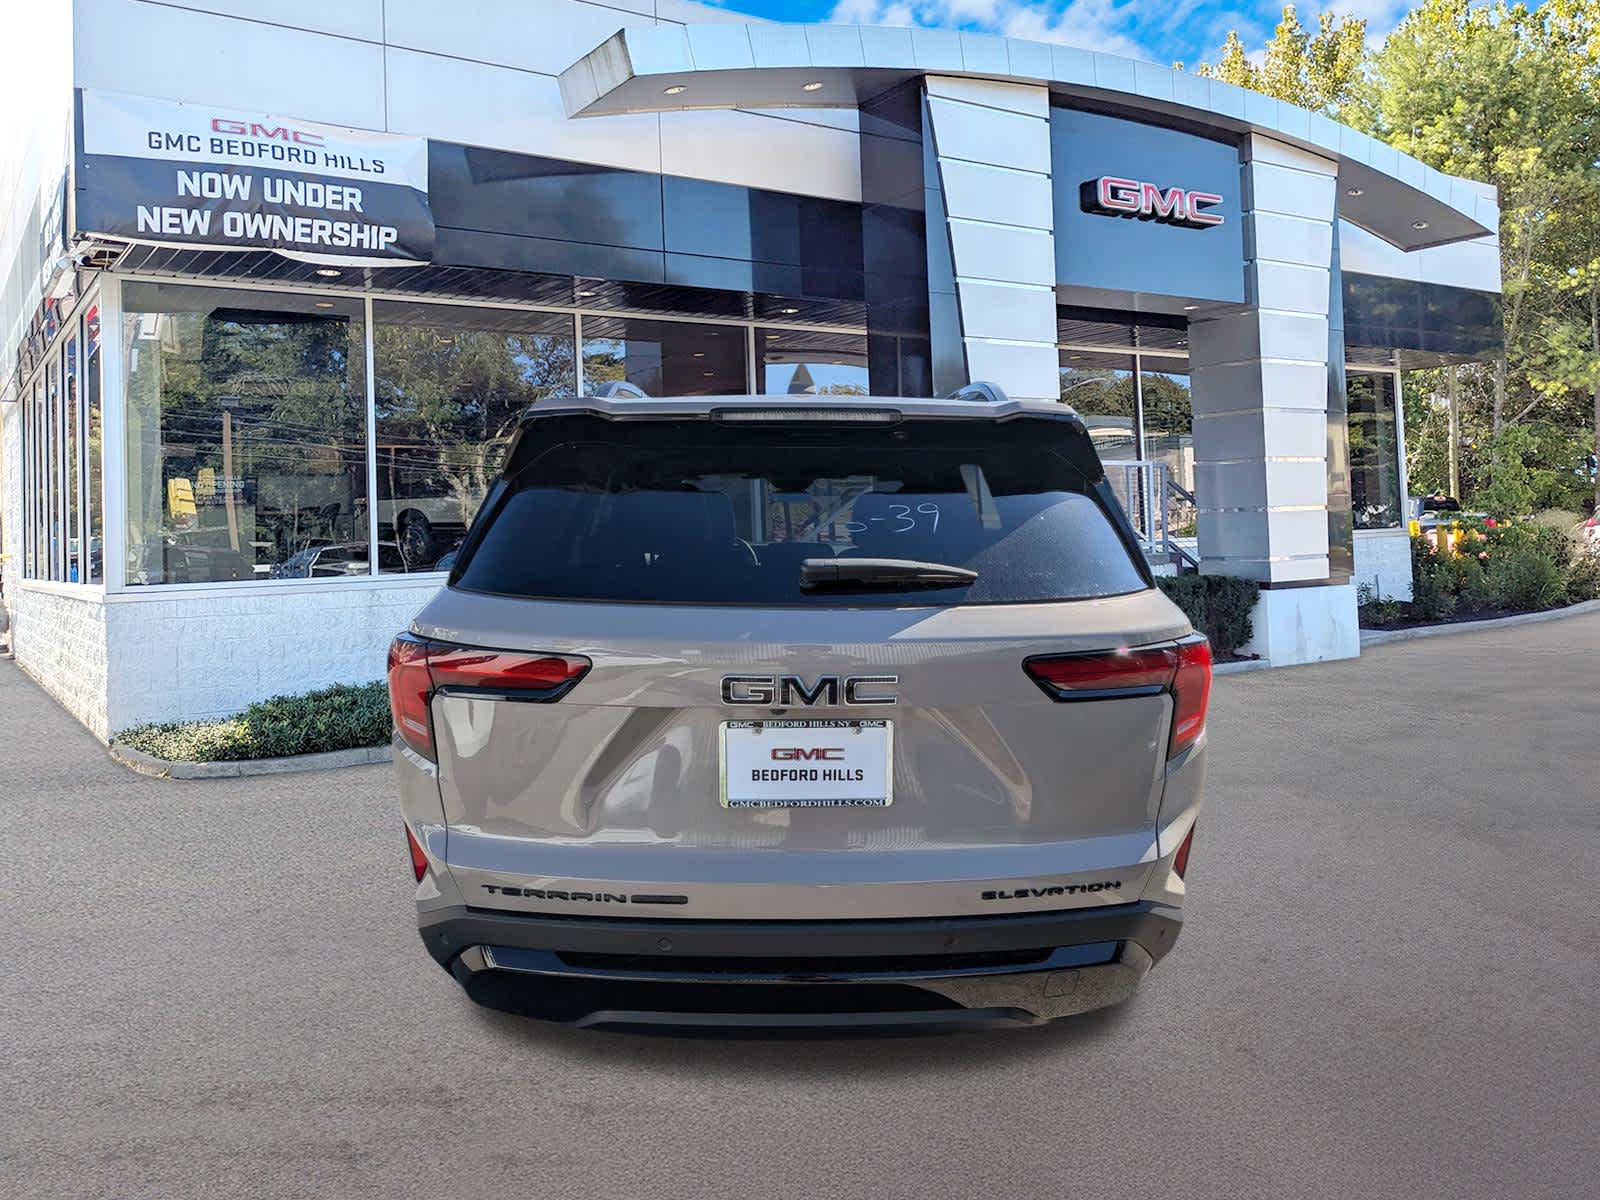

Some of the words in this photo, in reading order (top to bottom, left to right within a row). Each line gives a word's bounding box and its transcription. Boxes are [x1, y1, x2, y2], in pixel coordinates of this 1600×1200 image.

[211, 118, 325, 148] GMC
[148, 131, 201, 153] GMC
[210, 139, 317, 166] BEDFORD
[324, 154, 385, 174] HILLS
[176, 170, 252, 201] NOW
[263, 176, 364, 213] UNDER
[1096, 175, 1225, 225] GMC
[136, 206, 212, 236] NEW
[223, 211, 398, 250] OWNERSHIP
[719, 672, 899, 707] GMC
[762, 720, 807, 728] BEDFORD
[809, 720, 835, 728] HILLS
[770, 747, 845, 761] GMC
[751, 769, 818, 782] BEDFORD
[822, 769, 864, 782] HILLS
[729, 799, 884, 808] GMCBEDFORDHILLS.COM
[481, 884, 627, 904] TERRAIN
[981, 880, 1122, 900] ELEVATION
